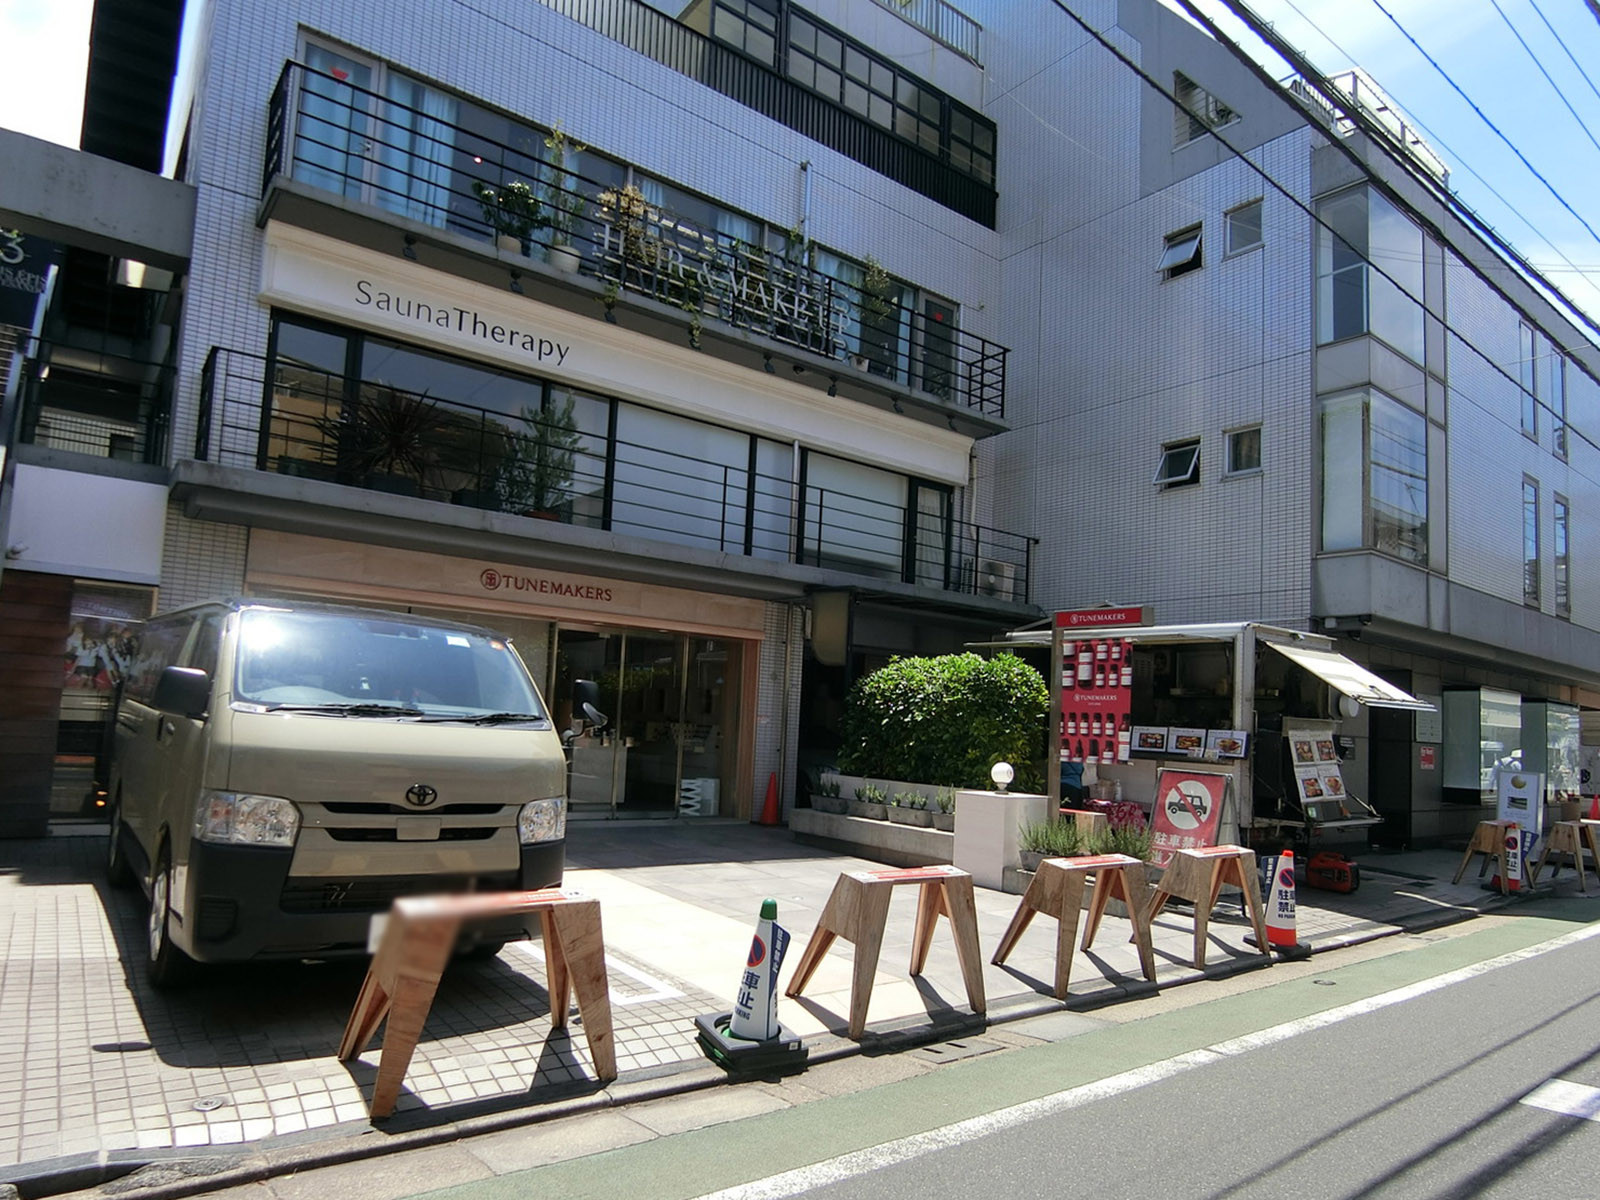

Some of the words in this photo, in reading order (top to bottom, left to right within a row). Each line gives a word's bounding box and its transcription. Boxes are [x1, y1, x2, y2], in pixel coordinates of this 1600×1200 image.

[696, 260, 720, 291] &
[727, 271, 809, 324] MAKE
[355, 280, 570, 366] SaunaTherapy
[502, 575, 613, 602] TUNEMAKERS
[1079, 613, 1126, 622] TUNEMAKERS
[1154, 831, 1208, 849] 駐車禁止
[741, 969, 760, 990] 車
[737, 986, 755, 1010] 止
